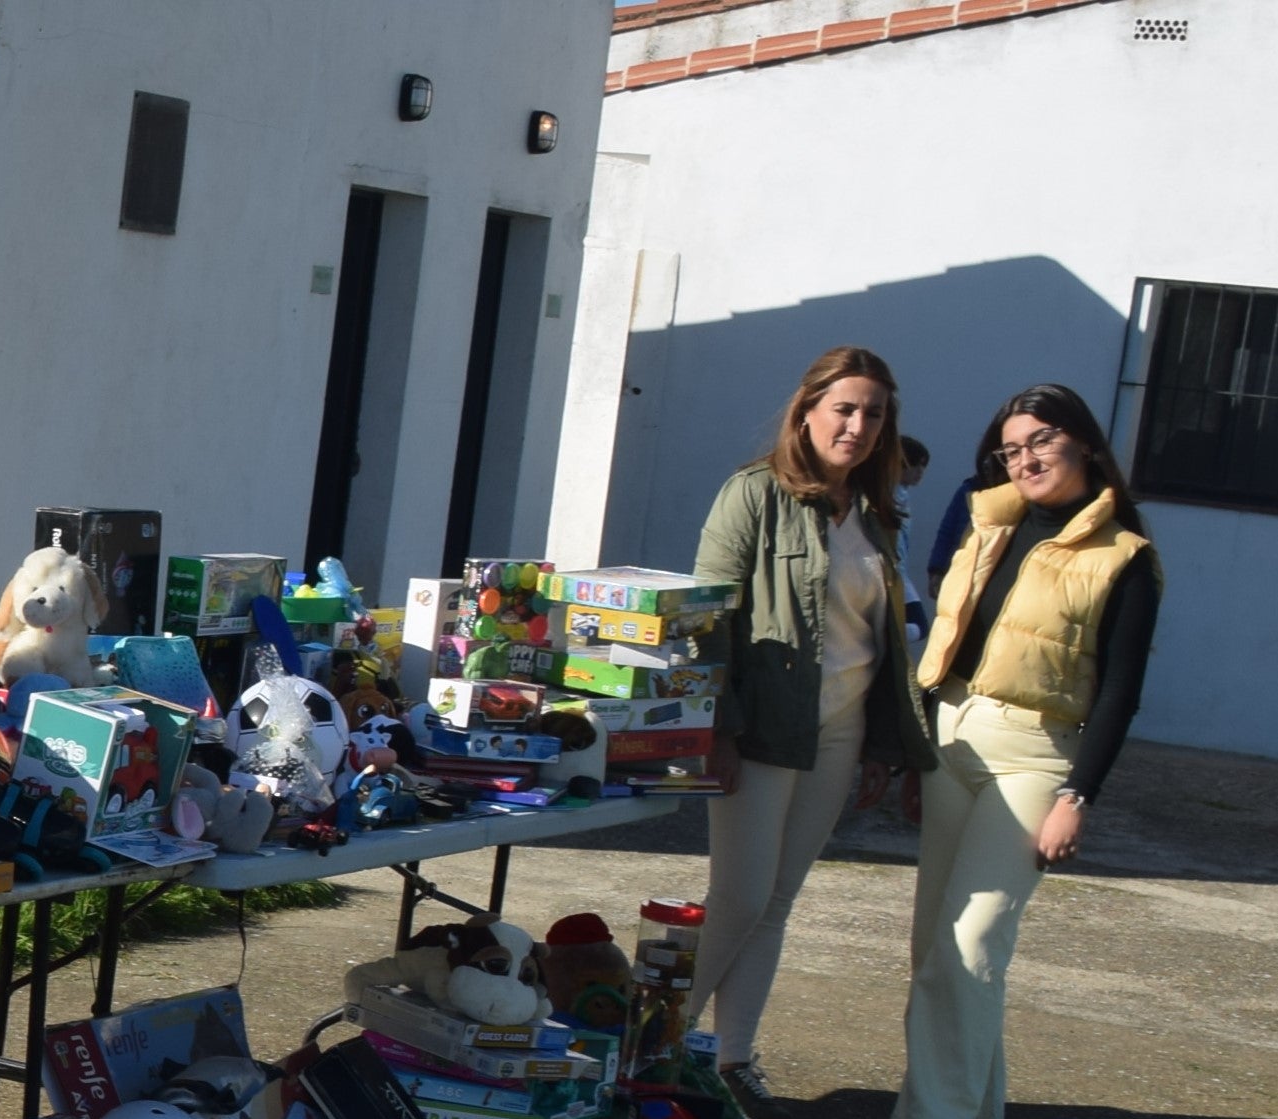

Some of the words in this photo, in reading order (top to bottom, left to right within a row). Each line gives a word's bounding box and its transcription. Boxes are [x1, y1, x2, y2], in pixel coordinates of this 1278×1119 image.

[106, 1022, 149, 1062] renfe
[71, 1034, 105, 1101] renfe
[437, 1086, 463, 1098] ABC
